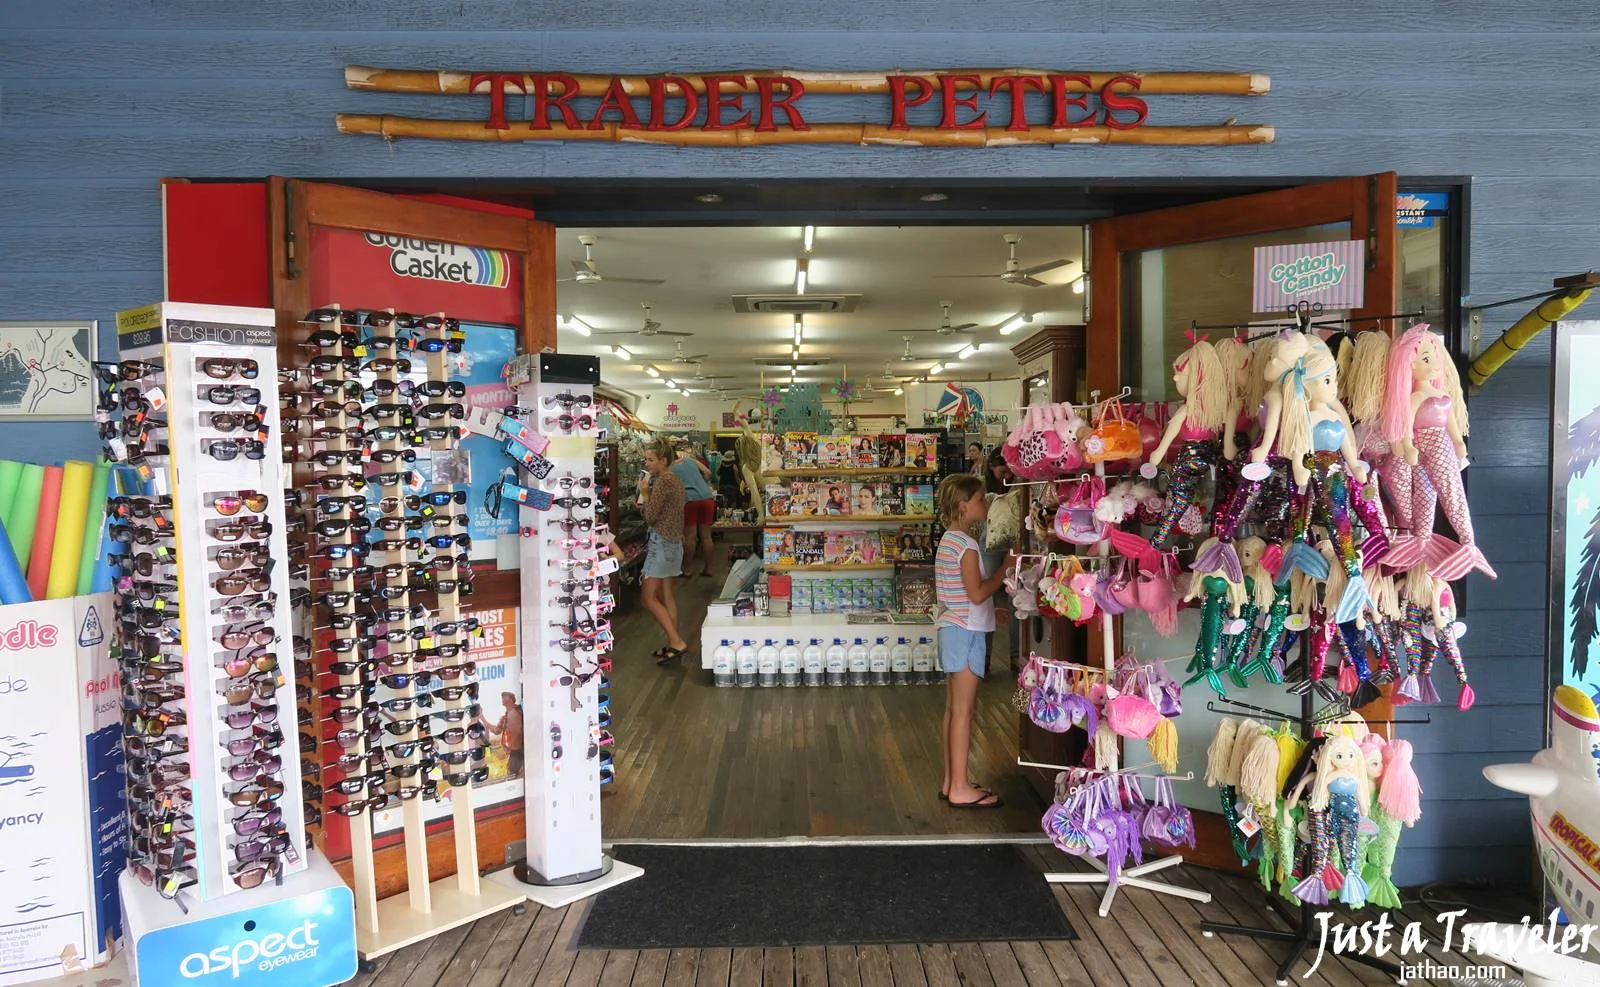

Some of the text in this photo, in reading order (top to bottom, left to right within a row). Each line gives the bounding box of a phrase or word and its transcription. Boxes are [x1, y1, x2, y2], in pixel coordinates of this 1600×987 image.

[469, 73, 1149, 131] TRADER PETES
[390, 250, 473, 283] Casket
[1270, 253, 1335, 283] Cotton
[1282, 265, 1346, 294] Candy
[469, 609, 504, 625] MOST
[0, 619, 58, 651] dle
[84, 674, 110, 697] Pool
[1549, 813, 1597, 863] TROPICAL
[179, 919, 320, 978] aspect
[258, 946, 320, 972] eyewear
